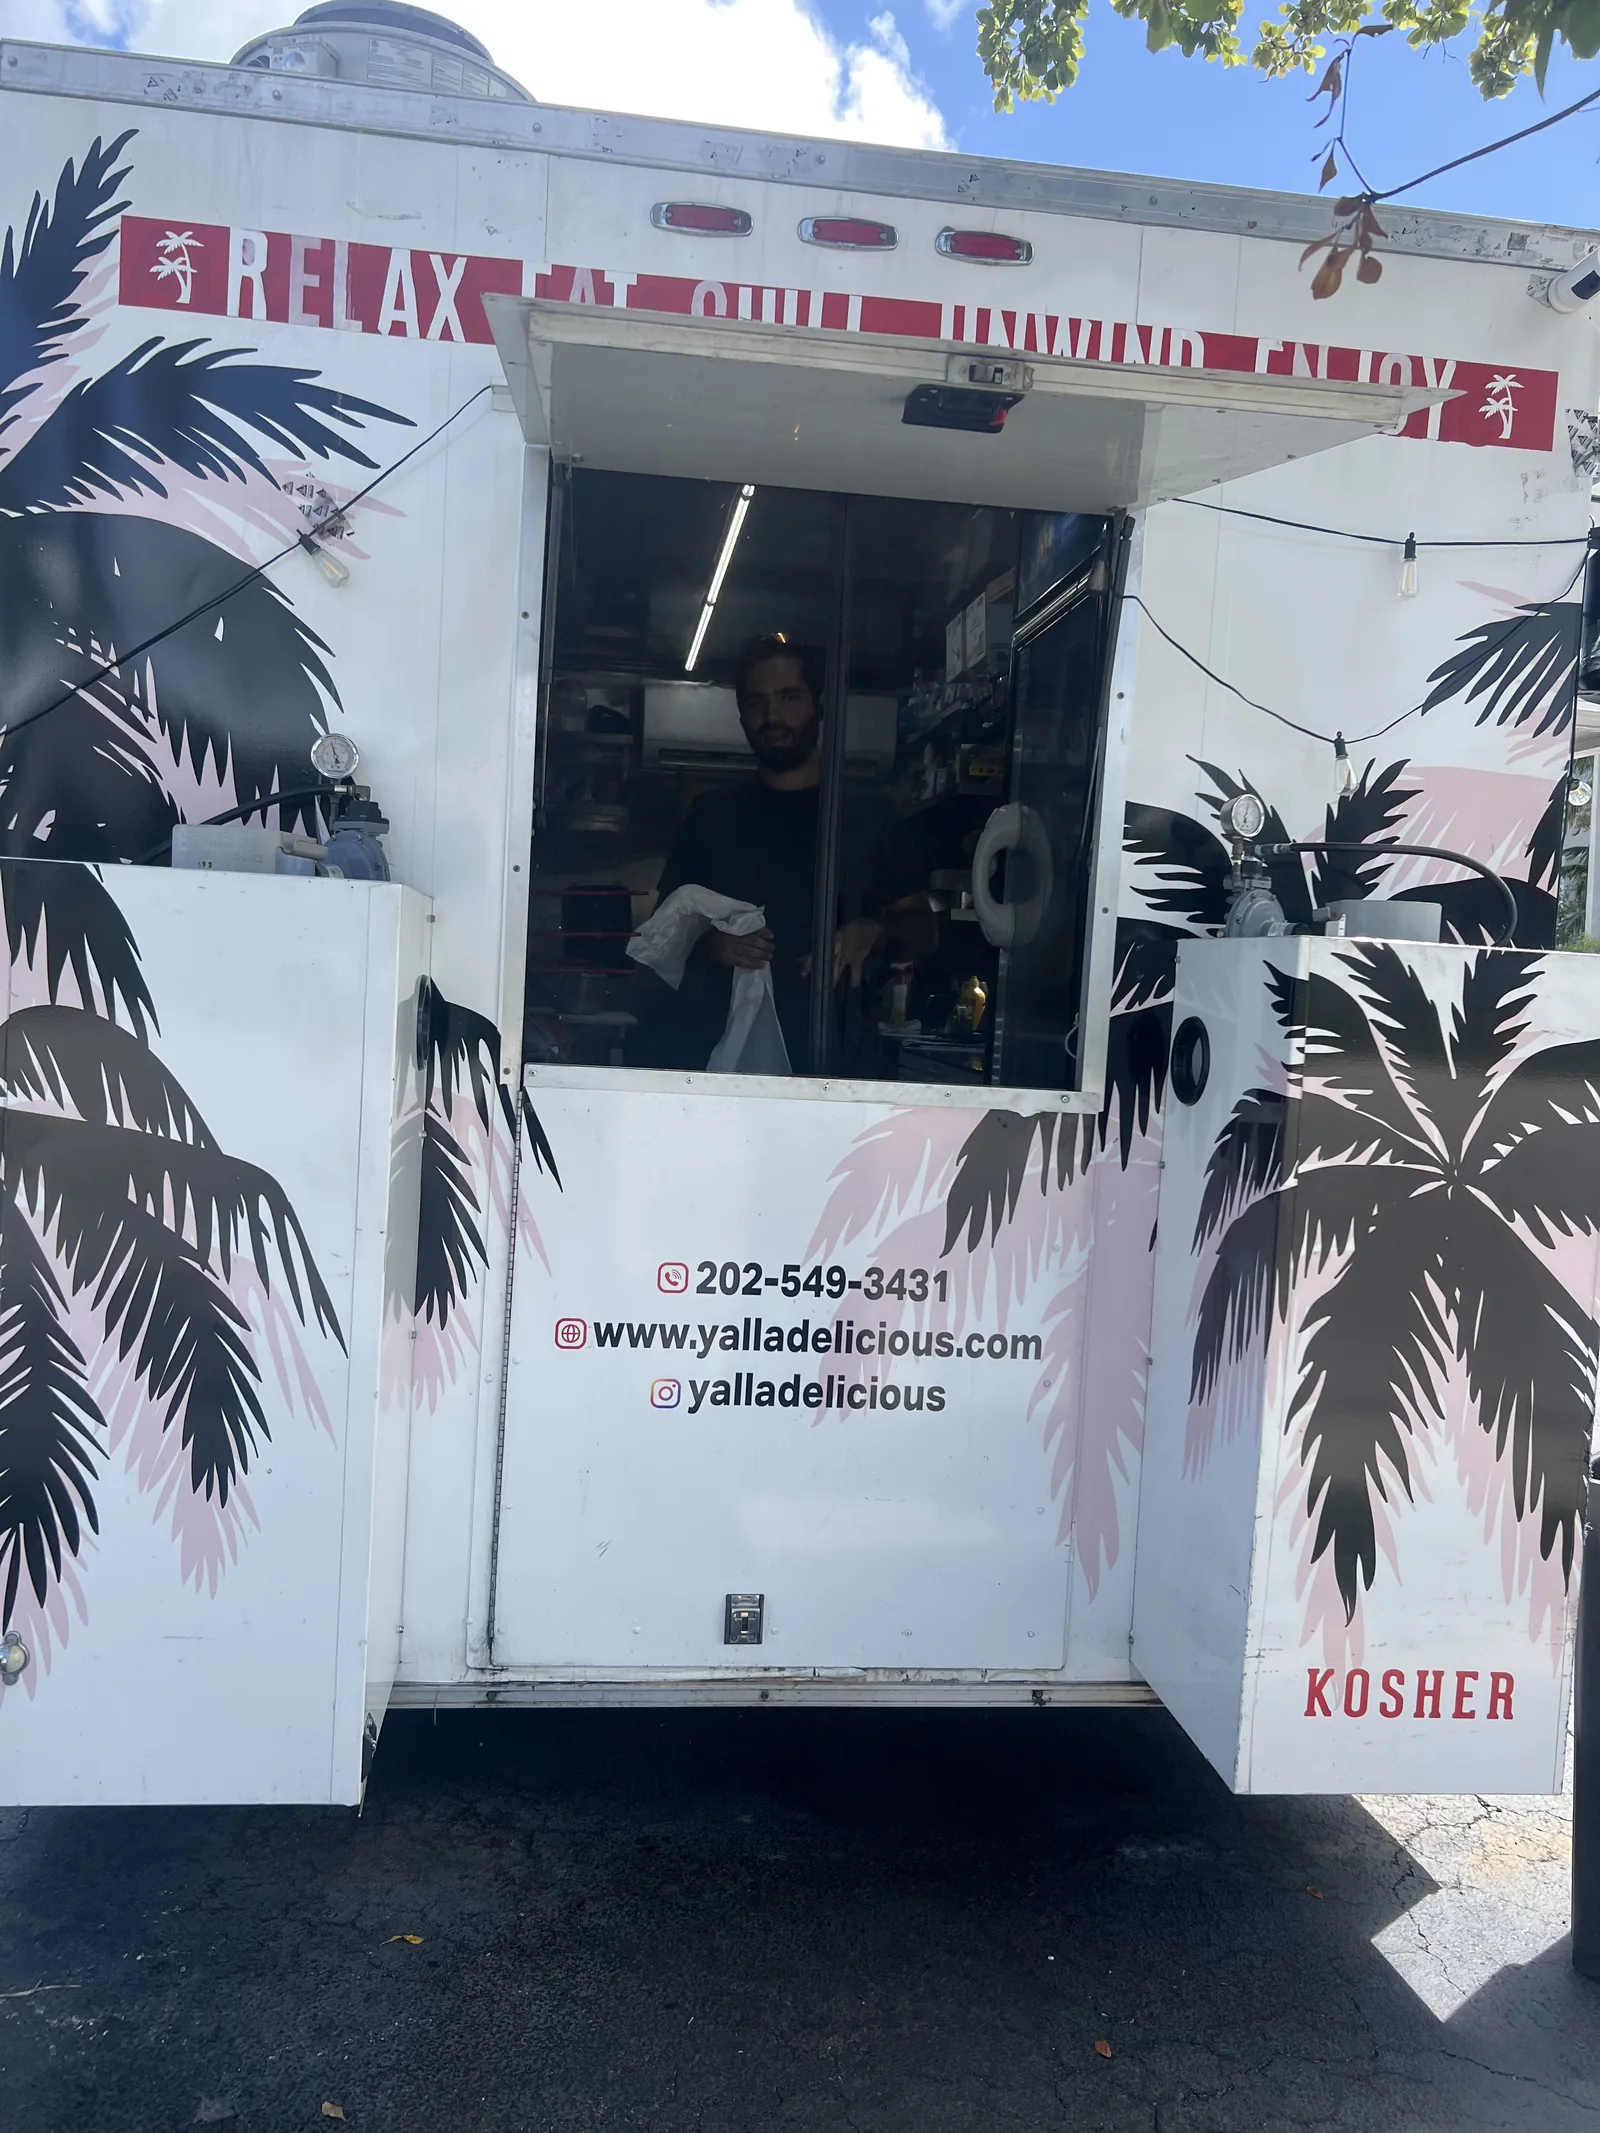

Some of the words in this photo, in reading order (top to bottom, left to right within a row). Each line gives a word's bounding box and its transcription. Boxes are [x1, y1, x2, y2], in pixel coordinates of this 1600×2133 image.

[227, 227, 468, 343] RELAX
[695, 1260, 948, 1302] 202-549-3431
[593, 1317, 1043, 1361] www.yalladelicious.com
[687, 1372, 946, 1414] yalladelicious
[1303, 1668, 1515, 1720] KOSHER
